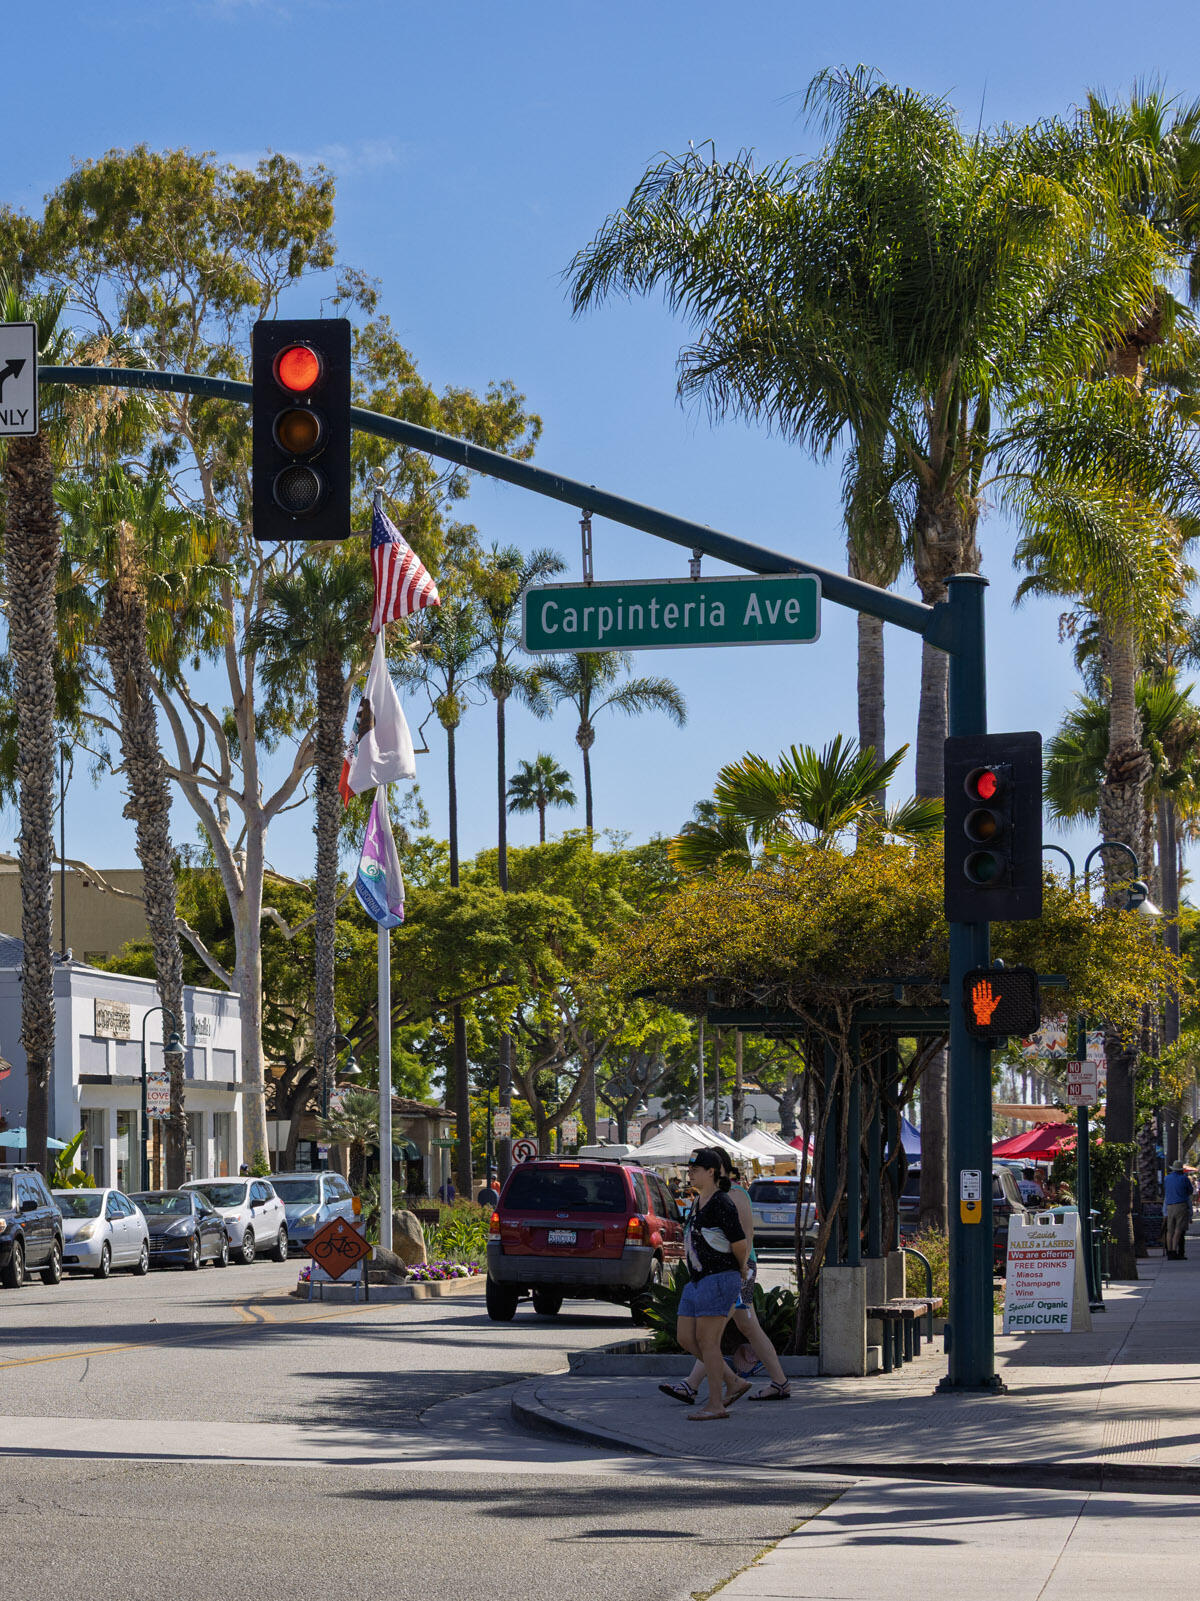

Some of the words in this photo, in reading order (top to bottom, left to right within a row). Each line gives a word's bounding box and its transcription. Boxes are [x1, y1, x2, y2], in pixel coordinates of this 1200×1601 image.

[541, 594, 725, 639] Carpinteria
[743, 592, 801, 626] Ave
[1069, 1062, 1080, 1073] NO
[1069, 1084, 1080, 1095] NO
[148, 1092, 169, 1100] LOVE
[1010, 1241, 1034, 1249] NAILS
[1042, 1240, 1074, 1248] LASHES
[1011, 1251, 1024, 1259] We
[1041, 1251, 1073, 1259] offering
[1037, 1261, 1067, 1269] DRINKS
[1016, 1281, 1060, 1289] Champagne
[1008, 1301, 1035, 1312] Special
[1037, 1301, 1068, 1310] Organic
[1008, 1314, 1068, 1324] PEDICURE
